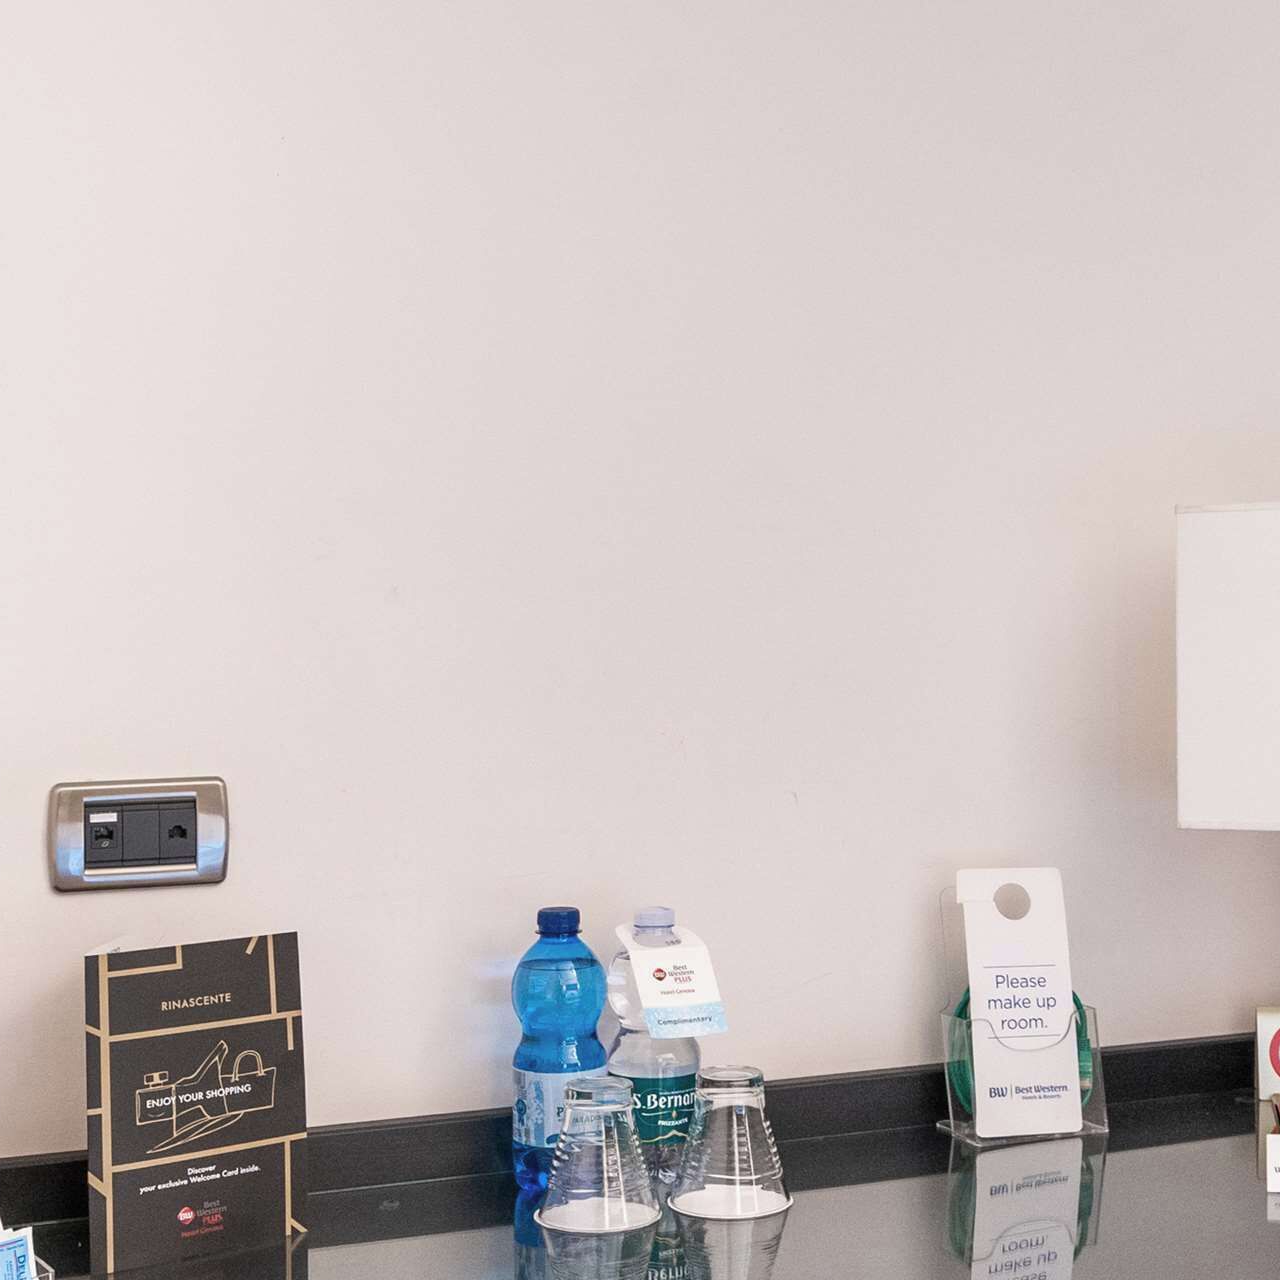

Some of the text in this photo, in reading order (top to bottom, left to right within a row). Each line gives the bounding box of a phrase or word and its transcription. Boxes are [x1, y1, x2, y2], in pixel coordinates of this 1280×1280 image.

[995, 974, 1047, 989] Please
[161, 993, 232, 1011] RINASCENTE
[987, 995, 1057, 1011] make up
[657, 1015, 713, 1025] Complimentary
[1001, 1017, 1048, 1030] room.
[146, 1083, 252, 1109] ENJOY YOUR SHOPPING
[989, 1084, 1068, 1098] BW Best Western
[187, 1165, 216, 1176] Discover
[139, 1164, 261, 1195] your exclusive Welcome Card inside.
[203, 1200, 221, 1208] Best
[197, 1206, 227, 1217] Western
[202, 1214, 223, 1225] PLUS
